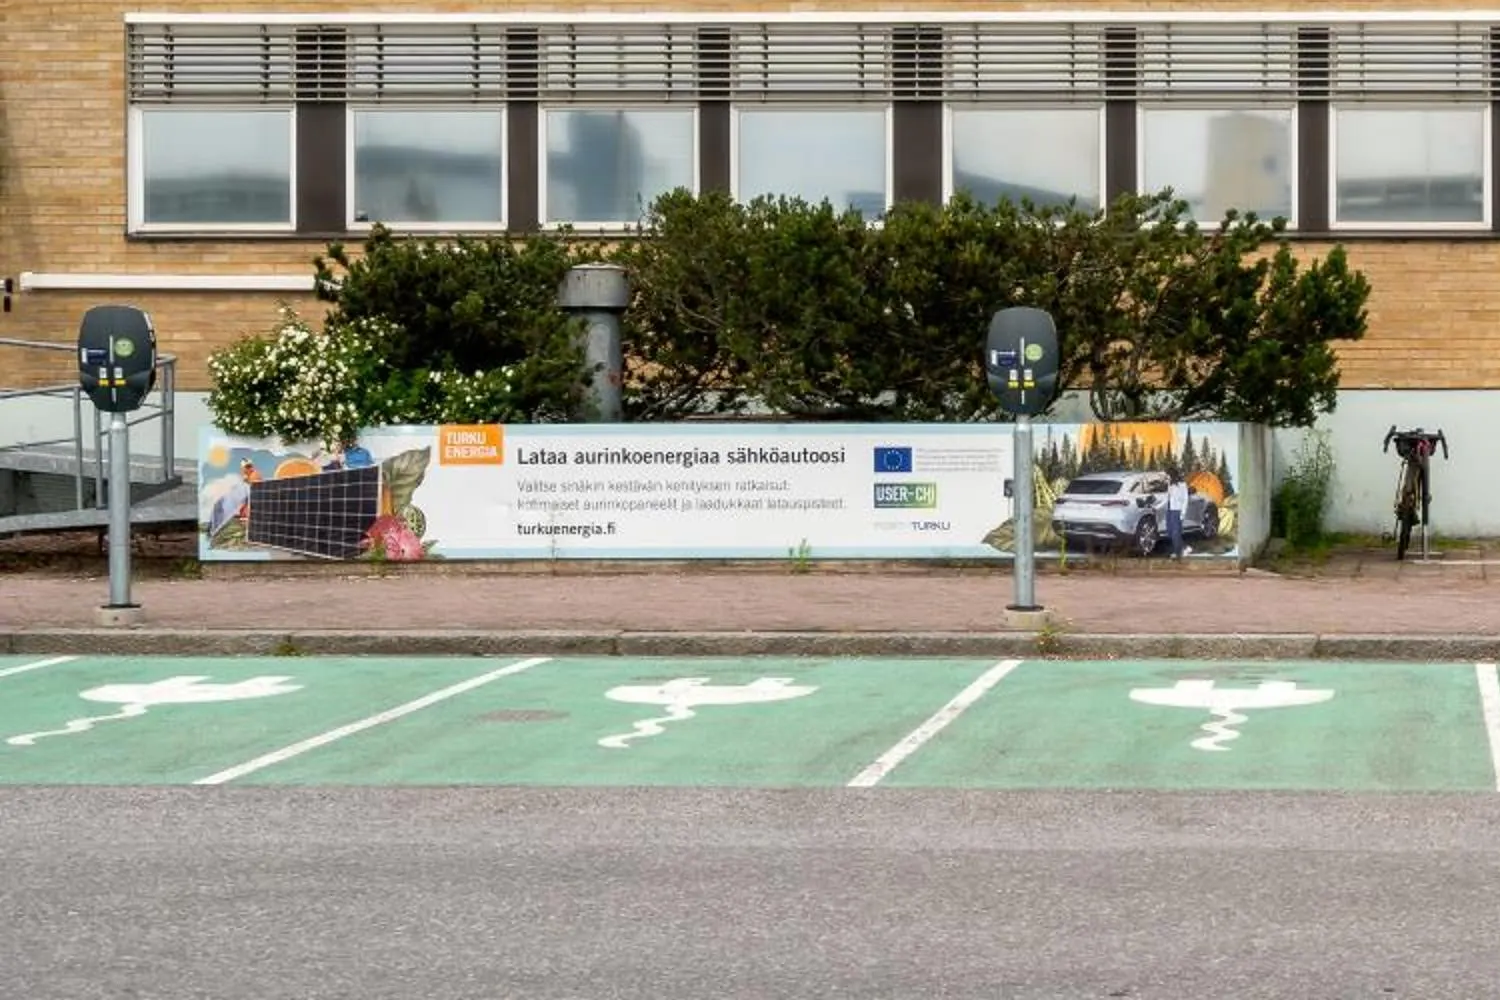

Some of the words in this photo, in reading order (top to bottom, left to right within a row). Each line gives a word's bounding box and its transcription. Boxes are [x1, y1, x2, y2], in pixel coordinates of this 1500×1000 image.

[447, 431, 487, 445] TURKU
[445, 445, 497, 458] ENERGIA
[517, 447, 568, 465] Lataa
[573, 447, 720, 469] aurinkoenergiaa
[727, 447, 846, 465] sähköautoosi
[517, 521, 616, 538] turkuenergia.fi
[911, 521, 951, 531] TURKU
